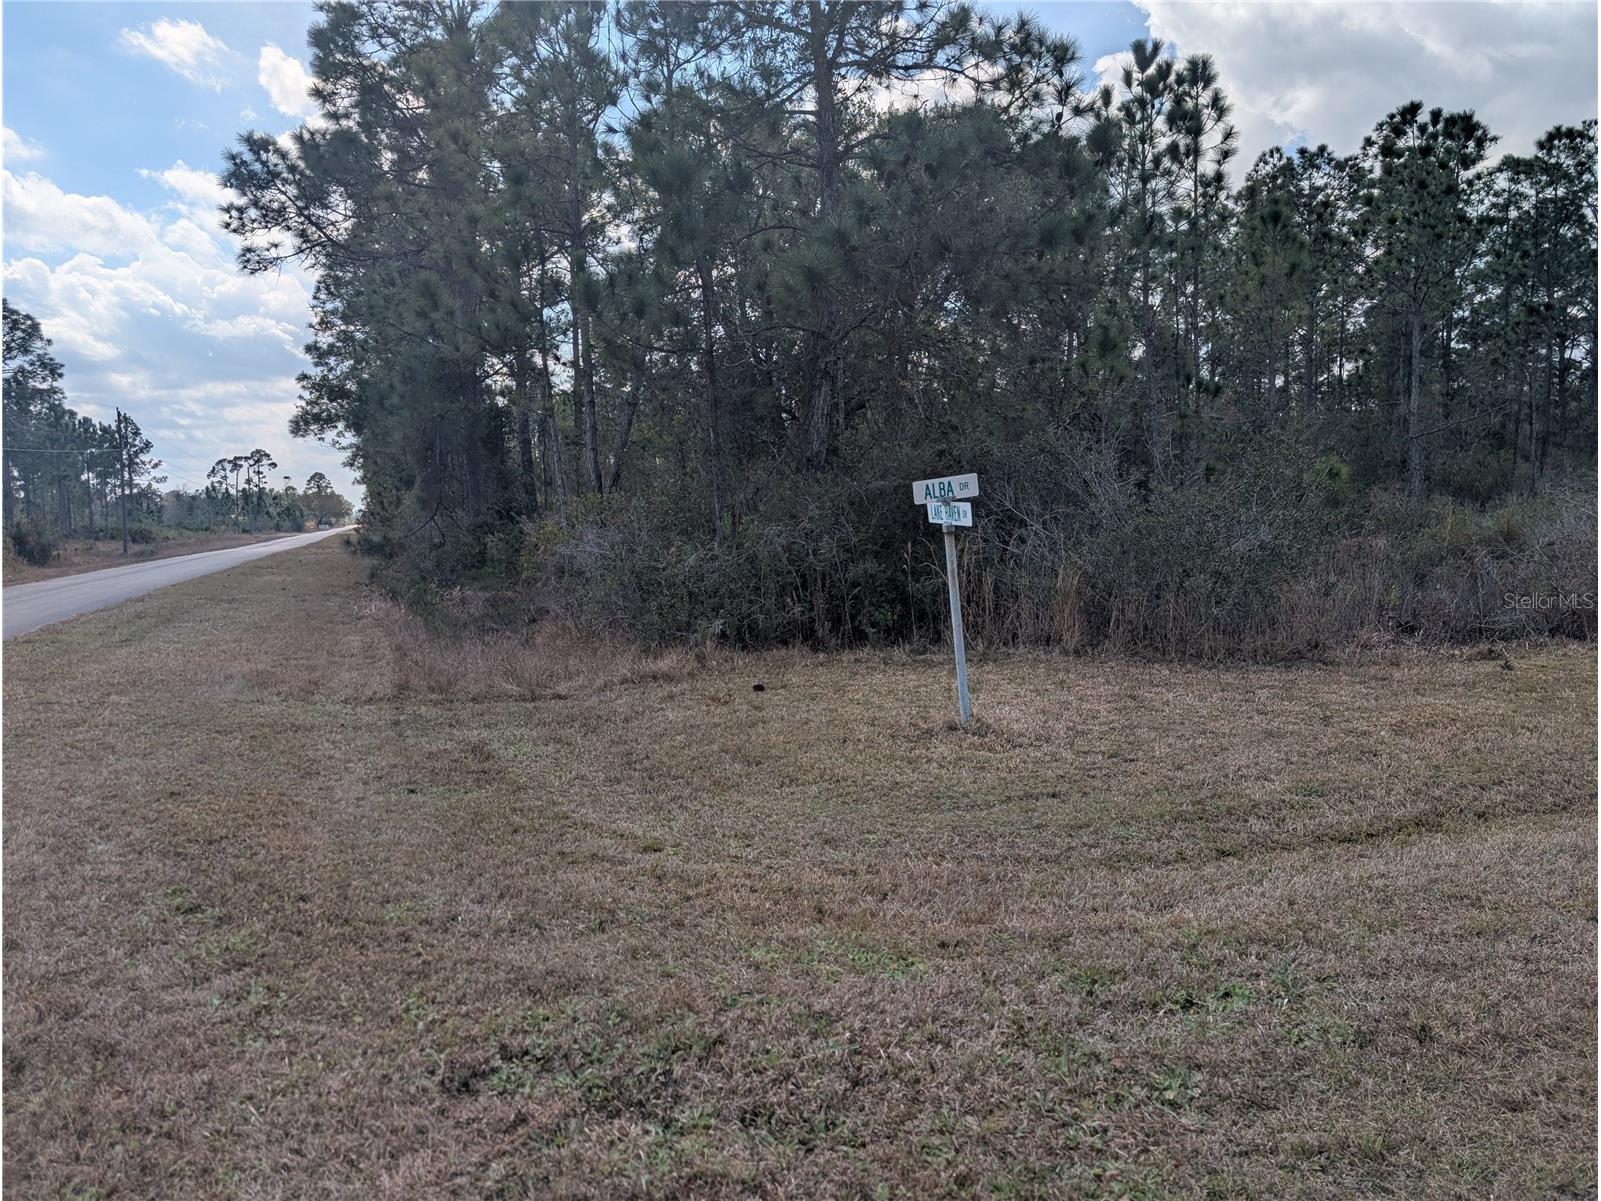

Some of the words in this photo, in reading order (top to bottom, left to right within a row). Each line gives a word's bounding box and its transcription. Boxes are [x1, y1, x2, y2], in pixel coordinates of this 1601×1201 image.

[924, 480, 954, 500] ALBA
[959, 481, 970, 491] DR
[931, 503, 944, 521] LAKE
[944, 505, 961, 522] HAVEN
